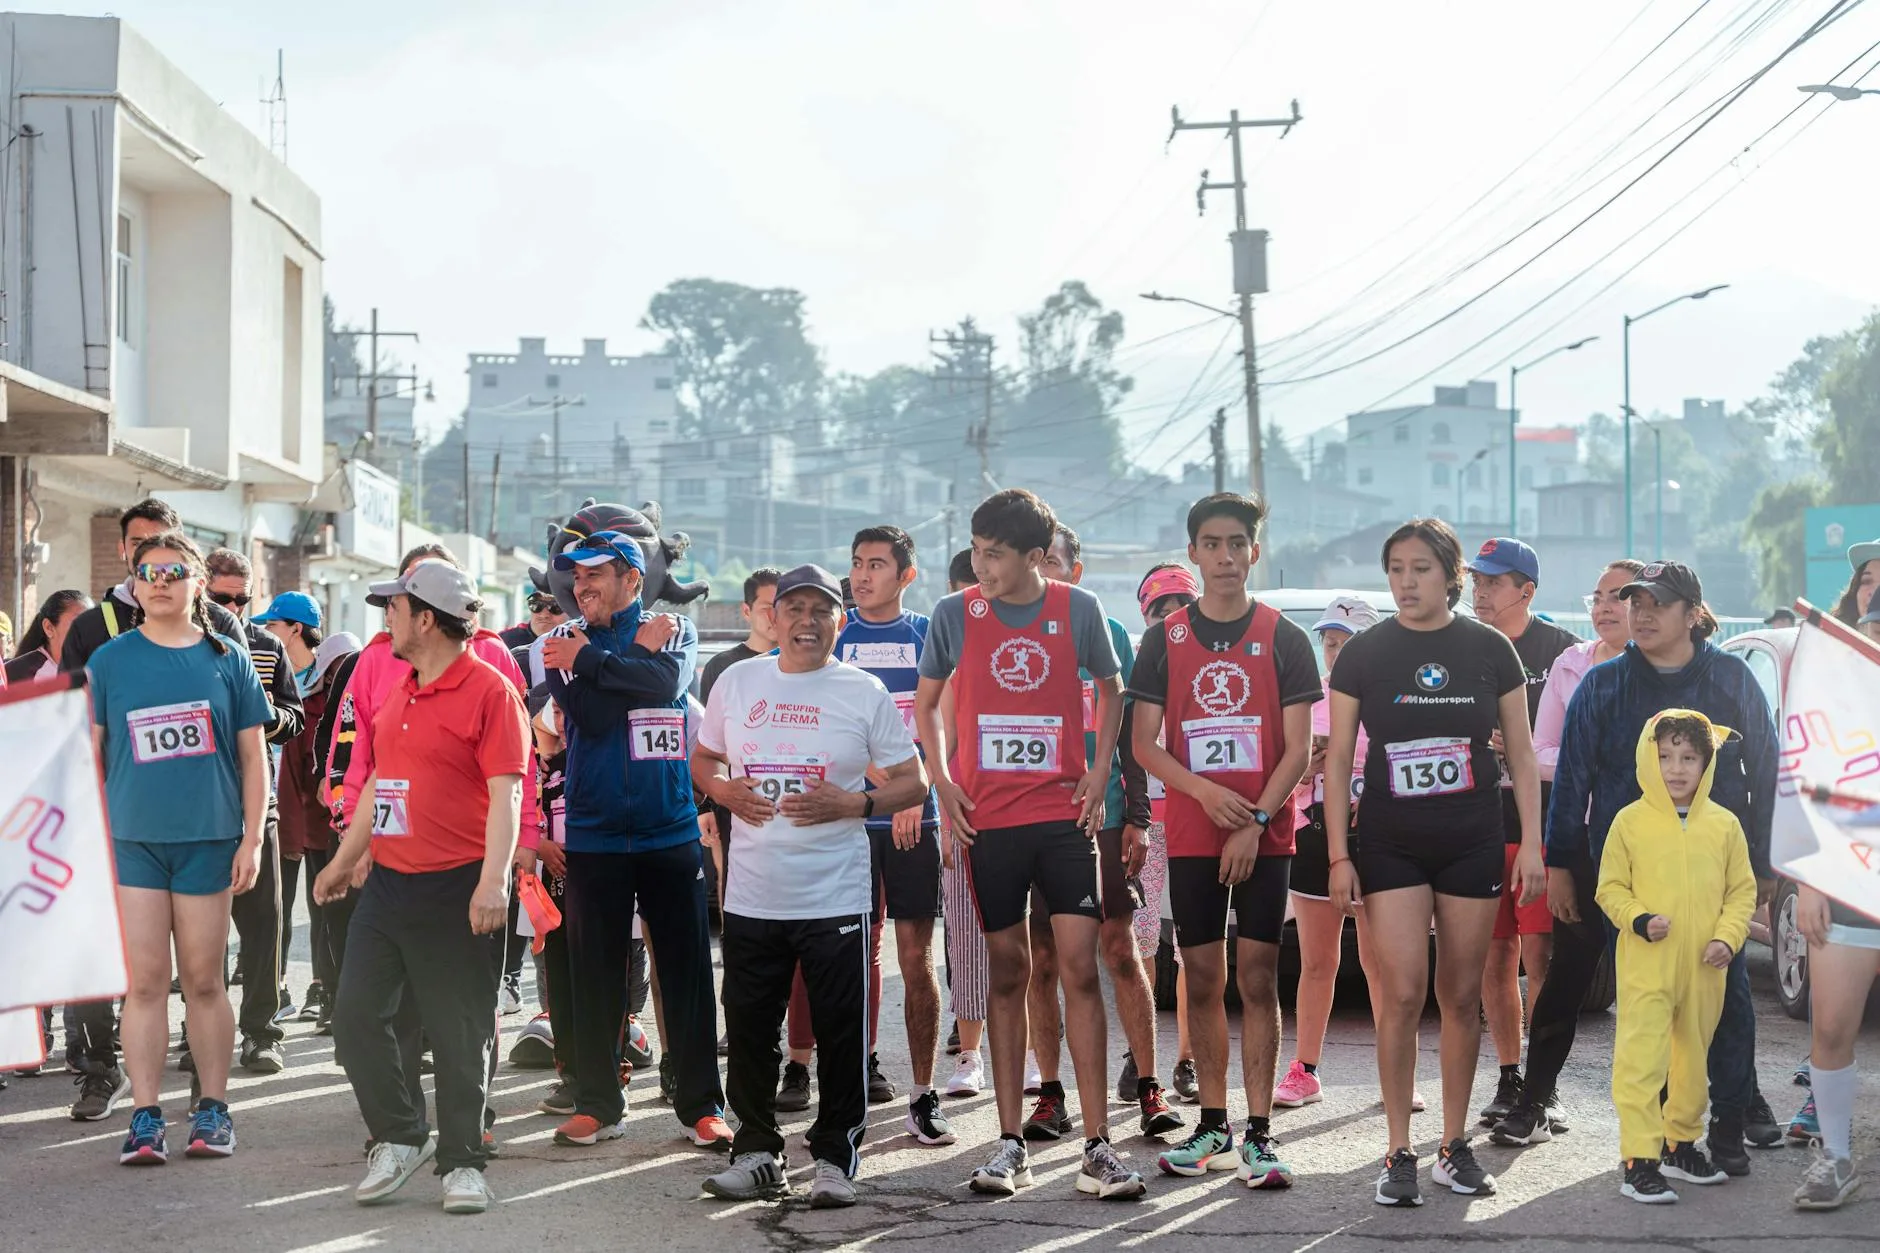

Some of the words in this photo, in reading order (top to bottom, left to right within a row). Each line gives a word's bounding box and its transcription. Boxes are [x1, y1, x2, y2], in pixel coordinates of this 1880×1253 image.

[775, 703, 821, 714] IMCUFIDE
[1419, 696, 1475, 705] Motorsport
[771, 713, 820, 726] LERMA
[143, 724, 201, 754] 108
[641, 729, 680, 753] 145
[991, 739, 1047, 765] 129
[1205, 739, 1237, 765] 21
[1400, 760, 1459, 790] 130
[762, 778, 802, 802] 95
